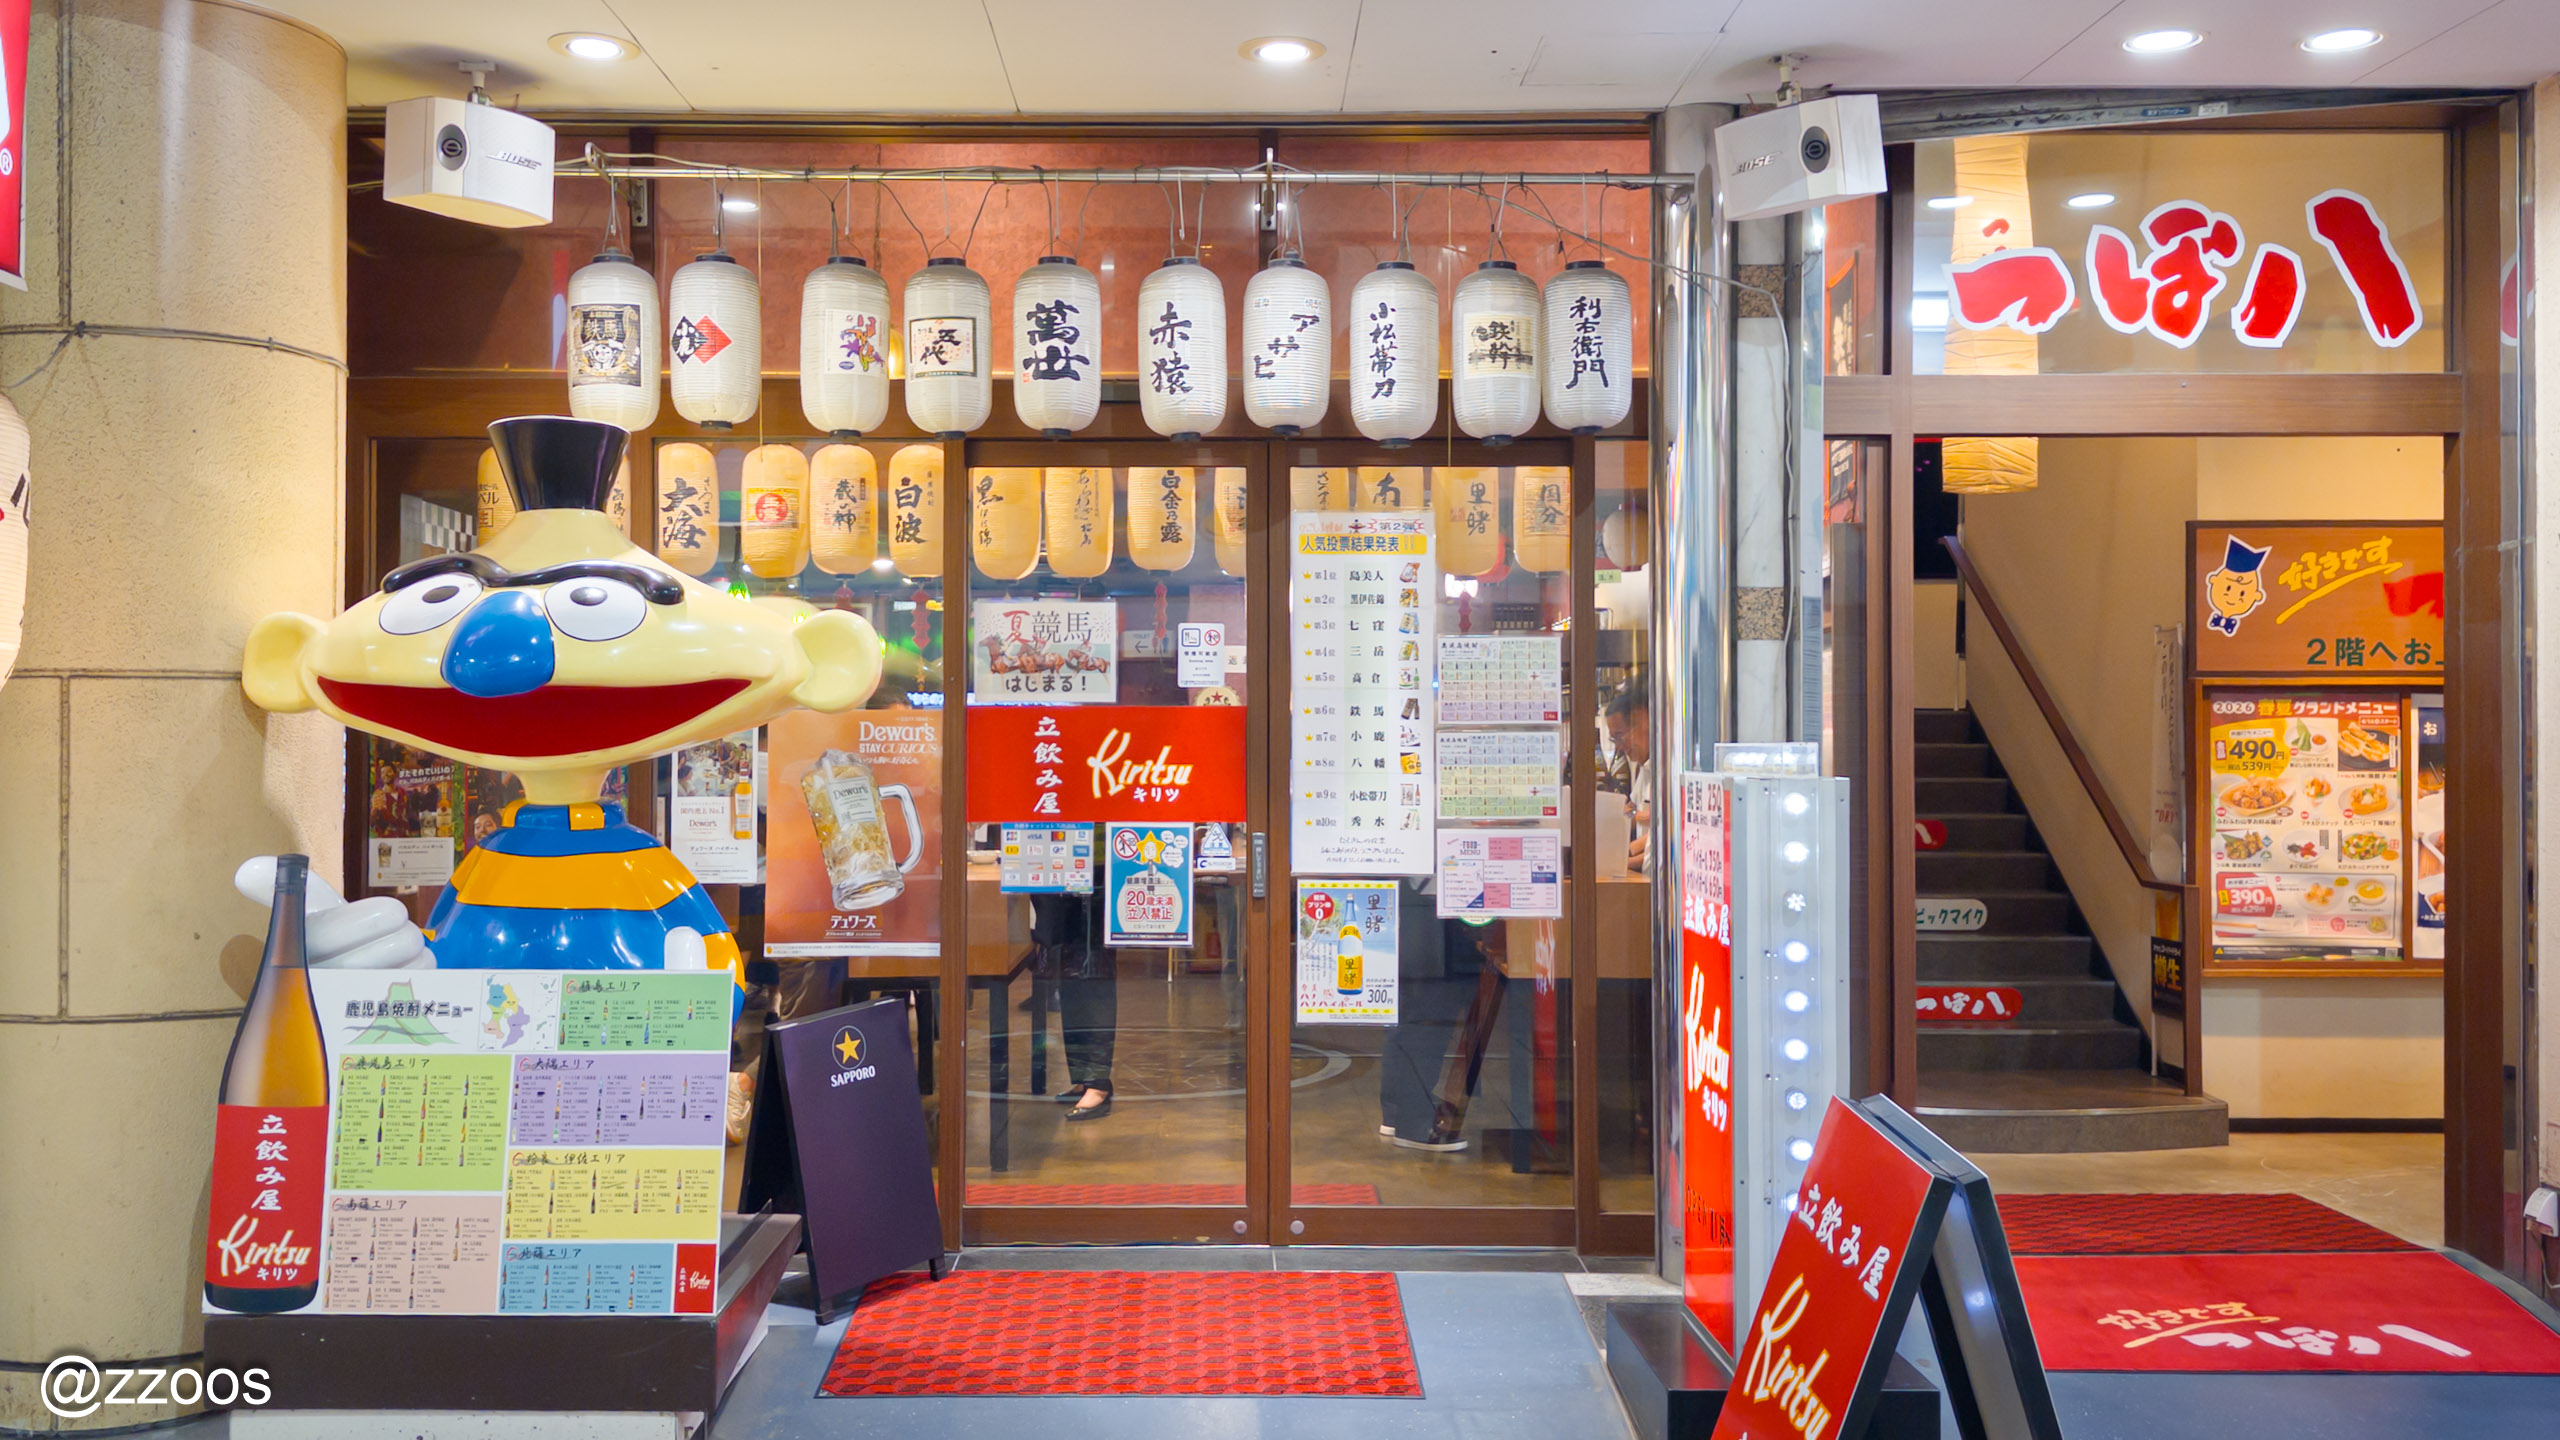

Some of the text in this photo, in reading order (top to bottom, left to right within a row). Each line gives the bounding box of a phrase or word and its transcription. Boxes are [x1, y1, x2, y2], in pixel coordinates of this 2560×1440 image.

[1735, 155, 1780, 174] BOSE
[1943, 189, 2424, 349] つぼ八
[920, 329, 961, 366] 五代
[1022, 300, 1090, 381] 萬世
[1148, 301, 1194, 396] 赤猿
[1253, 314, 1320, 380] アサヒ
[1369, 302, 1398, 399] 小松帯刀
[1565, 295, 1609, 390] 利右衛門
[660, 477, 706, 549] 大海
[894, 477, 927, 544] 白波
[1160, 469, 1183, 544] 白金乃露
[1539, 483, 1565, 525] 国分
[1314, 570, 1384, 581] 第1位 島美人
[2277, 536, 2393, 591] 好きです
[1314, 594, 1385, 605] 第2位 黒伊佐錦
[1002, 609, 1093, 645] 夏競馬
[1314, 619, 1385, 631] 第3位 七窪
[1314, 646, 1384, 657] 第4位 三岳
[2306, 637, 2444, 667] 2階へお
[1315, 672, 1381, 683] 第5位 高倉
[1314, 705, 1385, 717] 第6位 鉄馬
[2213, 702, 2255, 714] 2026
[859, 721, 935, 742] Dewar's
[1316, 730, 1385, 742] 第7位 小鹿
[859, 743, 937, 754] STAY CURIOUS
[1087, 728, 1194, 799] Kiritsu
[1315, 758, 1385, 769] 第8位 八幡
[2229, 740, 2285, 760] 490円
[1032, 716, 1064, 814] 立飲み屋
[1133, 788, 1180, 803] キリツ
[1316, 789, 1387, 802] 第9位 小松帯刀
[1316, 815, 1385, 827] 第10位 秀水
[1126, 889, 1174, 907] 20歳未満
[830, 914, 877, 929] デュワーズ
[1127, 907, 1174, 920] 立入禁止
[1315, 908, 1324, 920] 0
[1365, 894, 1386, 934] 里の曙
[1683, 893, 1731, 947] 立飲み屋
[345, 1000, 474, 1018] 鹿児島焼酎メニュー
[1686, 961, 1730, 1092] Kiritsu
[830, 1065, 876, 1088] SAPPORO
[1702, 1090, 1728, 1131] キリツ
[250, 1114, 289, 1211] 立飲み屋
[217, 1213, 312, 1278] Kiritsu
[1799, 1184, 1890, 1300] 立飲み屋
[256, 1265, 298, 1282] キリツ
[2097, 1302, 2255, 1331] 好きです
[2182, 1324, 2472, 1357] つぼ八
[1742, 1273, 1832, 1440] Kiritsu
